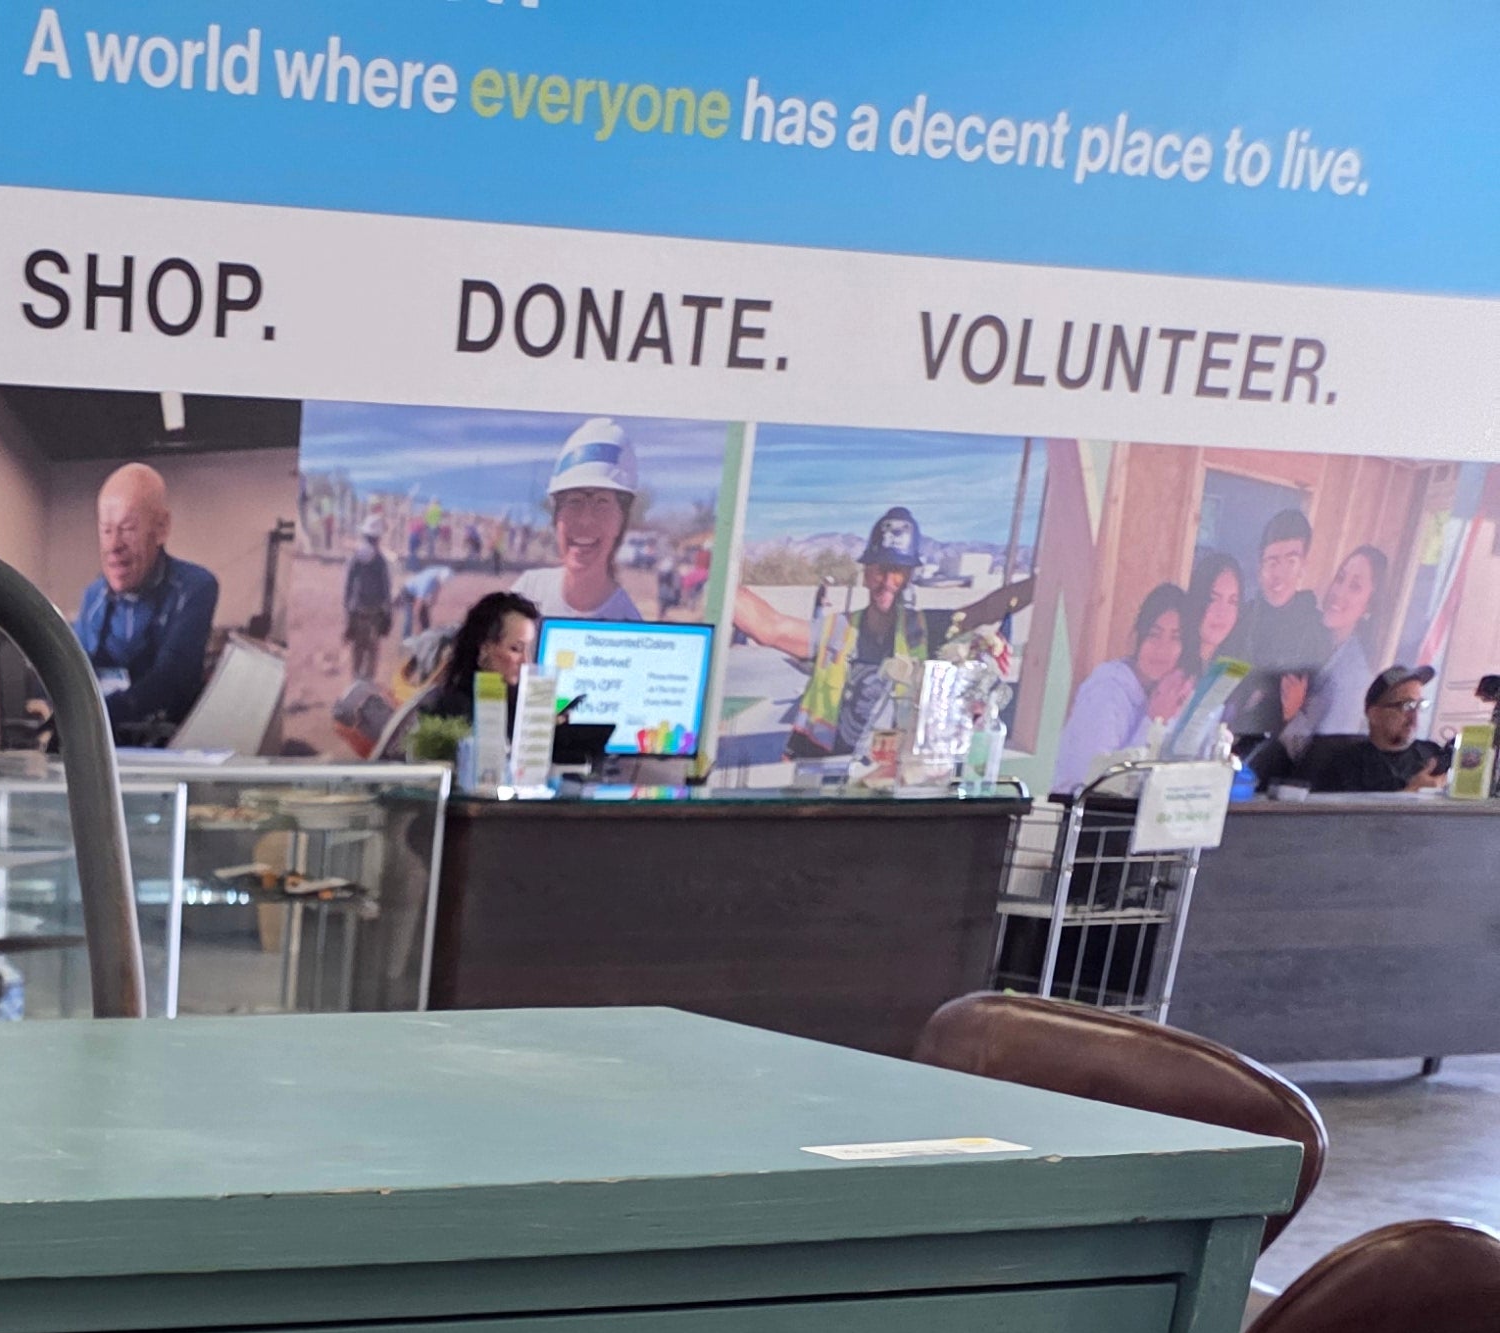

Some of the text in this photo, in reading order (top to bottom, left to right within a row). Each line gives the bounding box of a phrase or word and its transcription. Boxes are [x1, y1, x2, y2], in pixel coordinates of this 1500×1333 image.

[24, 8, 1370, 196] A world where everyone has a decent place to live.
[20, 248, 1339, 405] SHOP. DONATE. VOLUNTEER.
